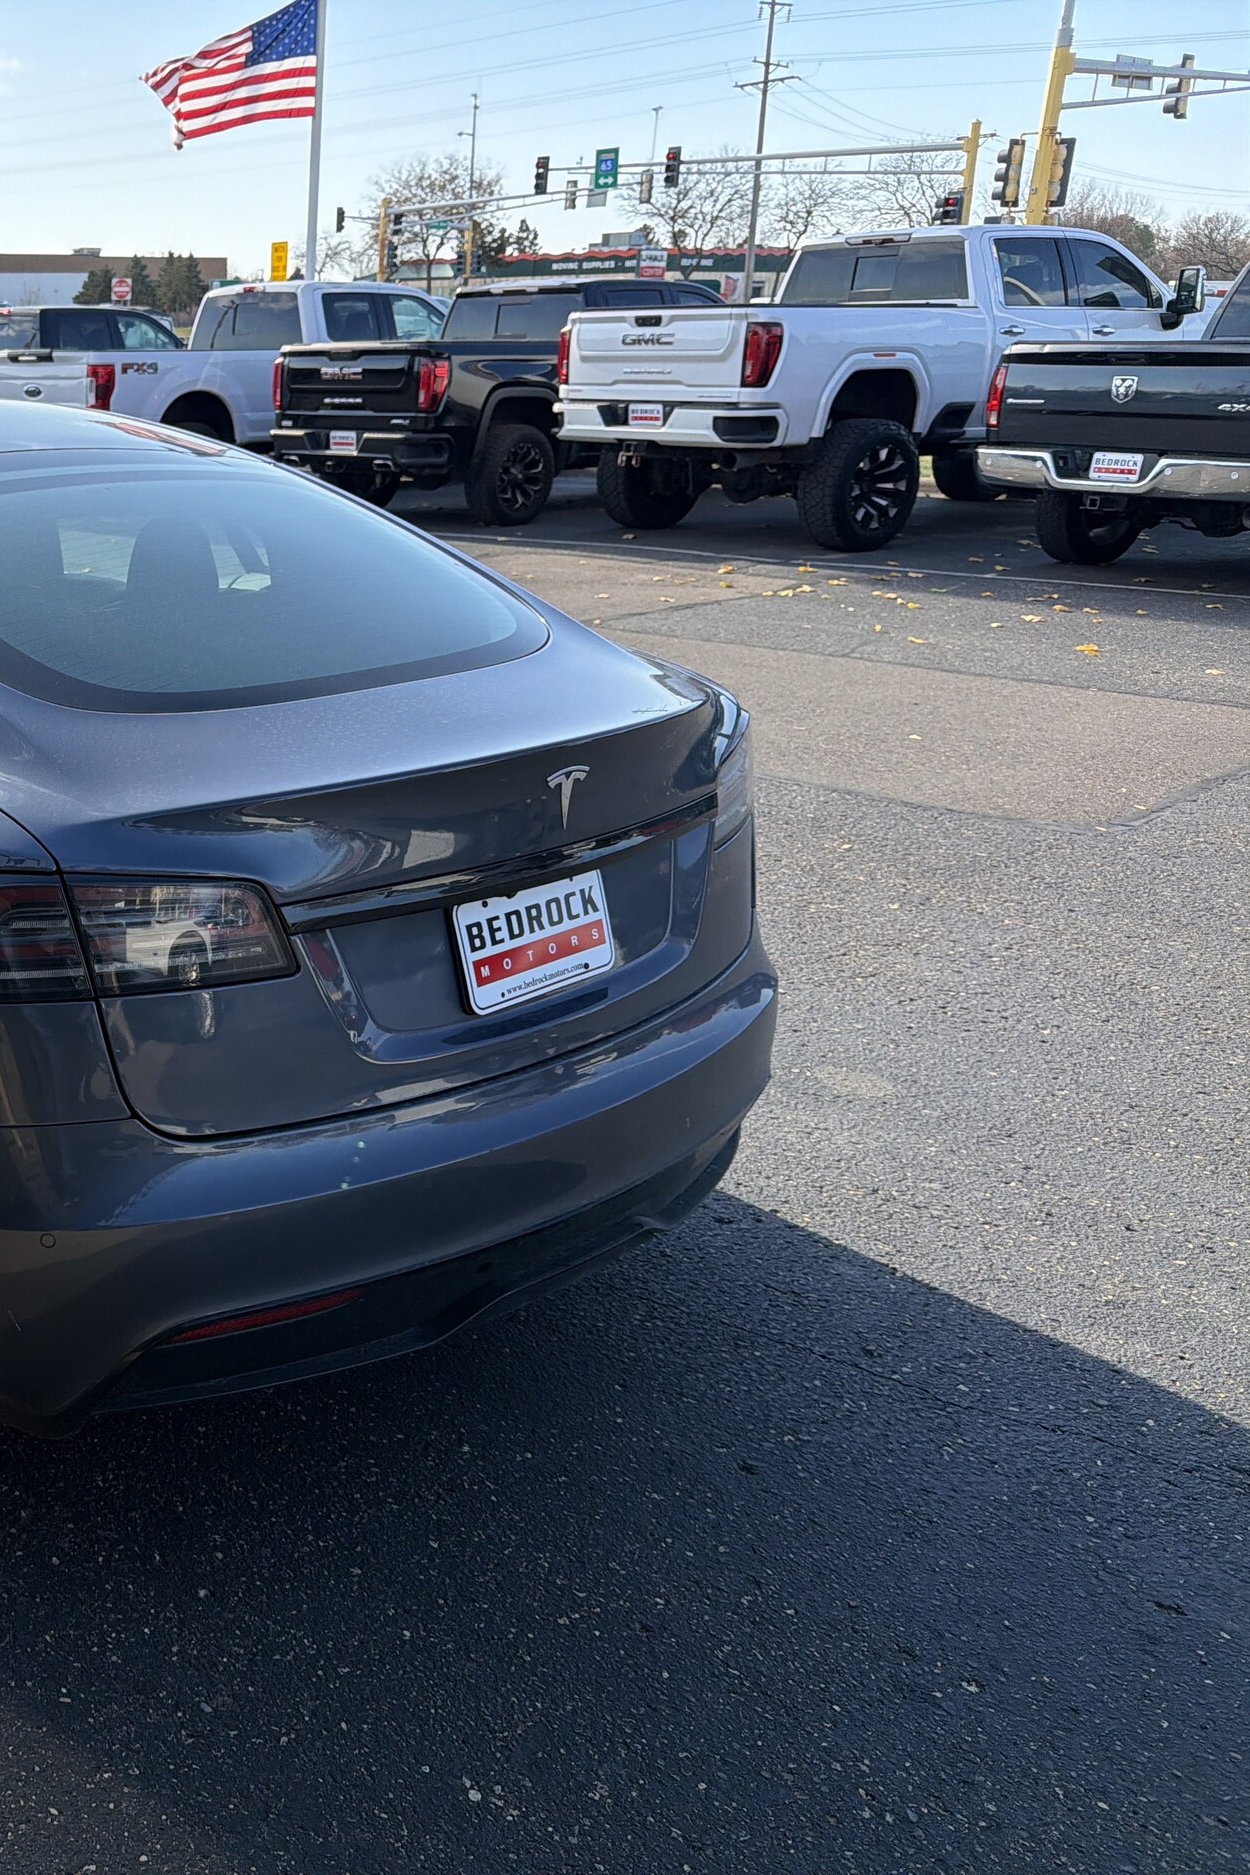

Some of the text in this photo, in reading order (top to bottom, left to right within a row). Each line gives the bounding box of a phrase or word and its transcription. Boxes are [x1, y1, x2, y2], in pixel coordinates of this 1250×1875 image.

[622, 333, 675, 346] GMC
[121, 362, 159, 375] FX4
[1094, 458, 1138, 468] BEDROCK
[465, 885, 600, 954] BEDROCK
[480, 928, 600, 978] MOTORS
[506, 961, 584, 995] www.bedrockmotors.com
